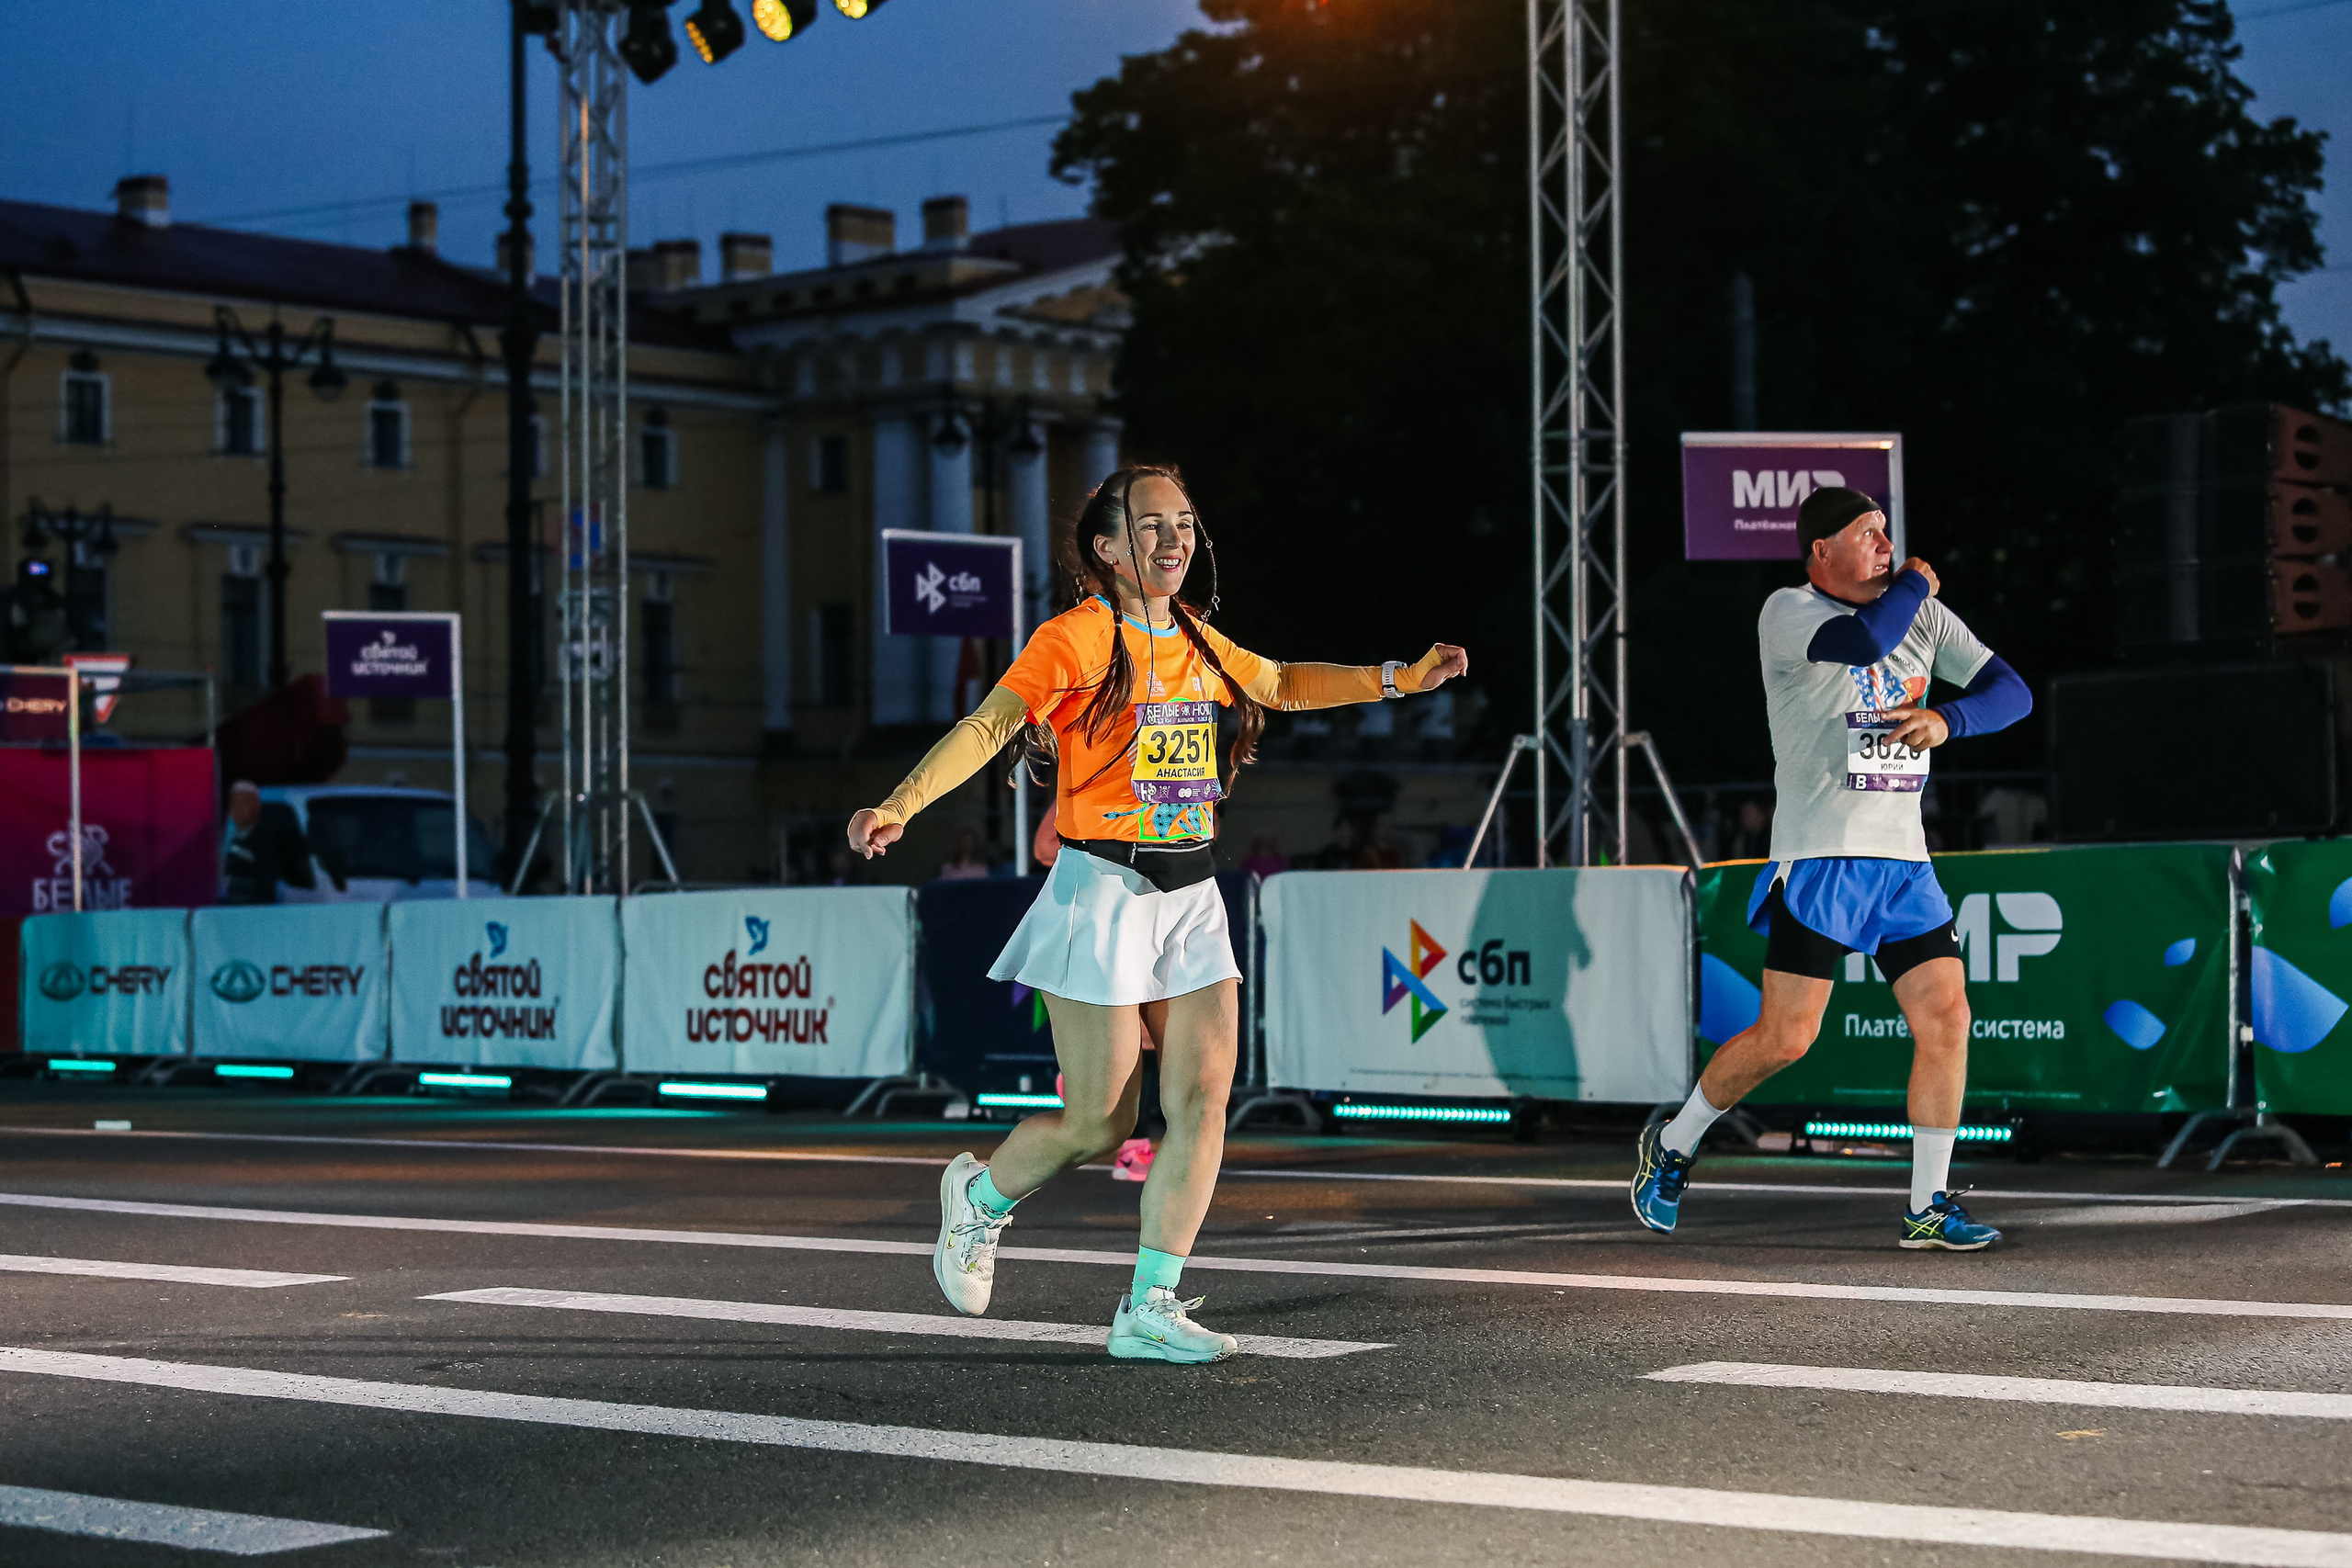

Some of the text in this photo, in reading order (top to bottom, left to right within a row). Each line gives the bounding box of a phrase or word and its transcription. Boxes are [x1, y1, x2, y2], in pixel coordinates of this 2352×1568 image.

[6, 696, 67, 714] CHERY
[1147, 704, 1180, 717] БЕЛЫЕ
[1855, 712, 1884, 724] БЕЛЫ
[1148, 729, 1209, 763] 3251
[1156, 767, 1205, 777] АНАСТАСИЯ
[1855, 774, 1867, 789] B
[1881, 762, 1904, 771] ЮРИЙ
[454, 952, 541, 998] святой
[704, 949, 812, 998] святой
[1457, 939, 1531, 987] сбп
[90, 965, 172, 996] CHERY
[271, 964, 365, 997] CHERY
[441, 1004, 557, 1040] источник
[686, 1007, 829, 1044] источник
[1845, 1013, 2064, 1040] Платё система
